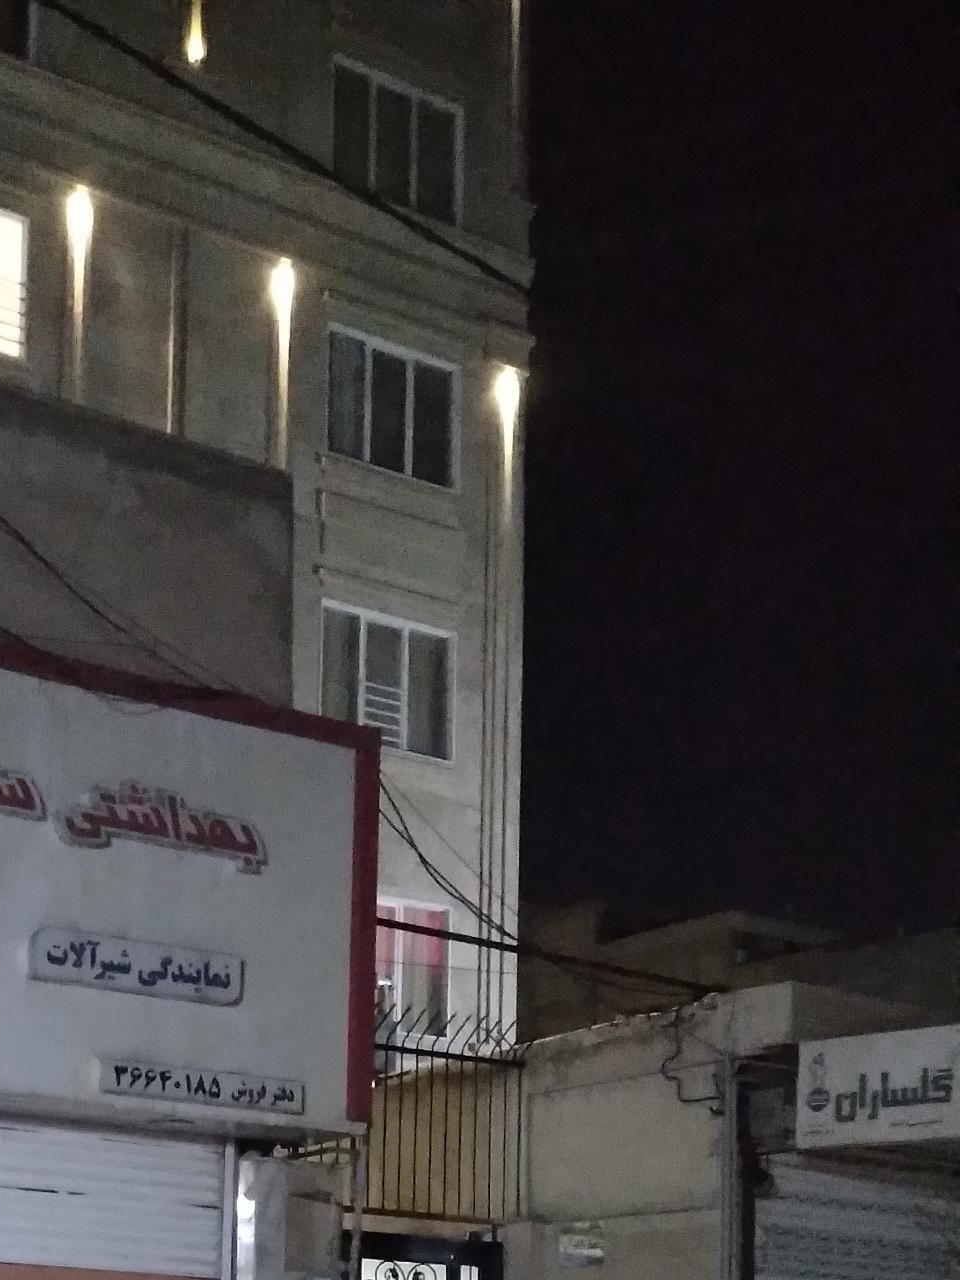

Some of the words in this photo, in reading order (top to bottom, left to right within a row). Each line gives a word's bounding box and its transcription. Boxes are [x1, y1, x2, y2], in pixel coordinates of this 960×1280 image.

[62, 781, 262, 868] بهداشتی
[138, 956, 231, 993] نمایندگی
[114, 1065, 221, 1099] ۳۶۶۴۰۱۸۵
[231, 1081, 267, 1105] فروش
[271, 1085, 295, 1106] دفتر
